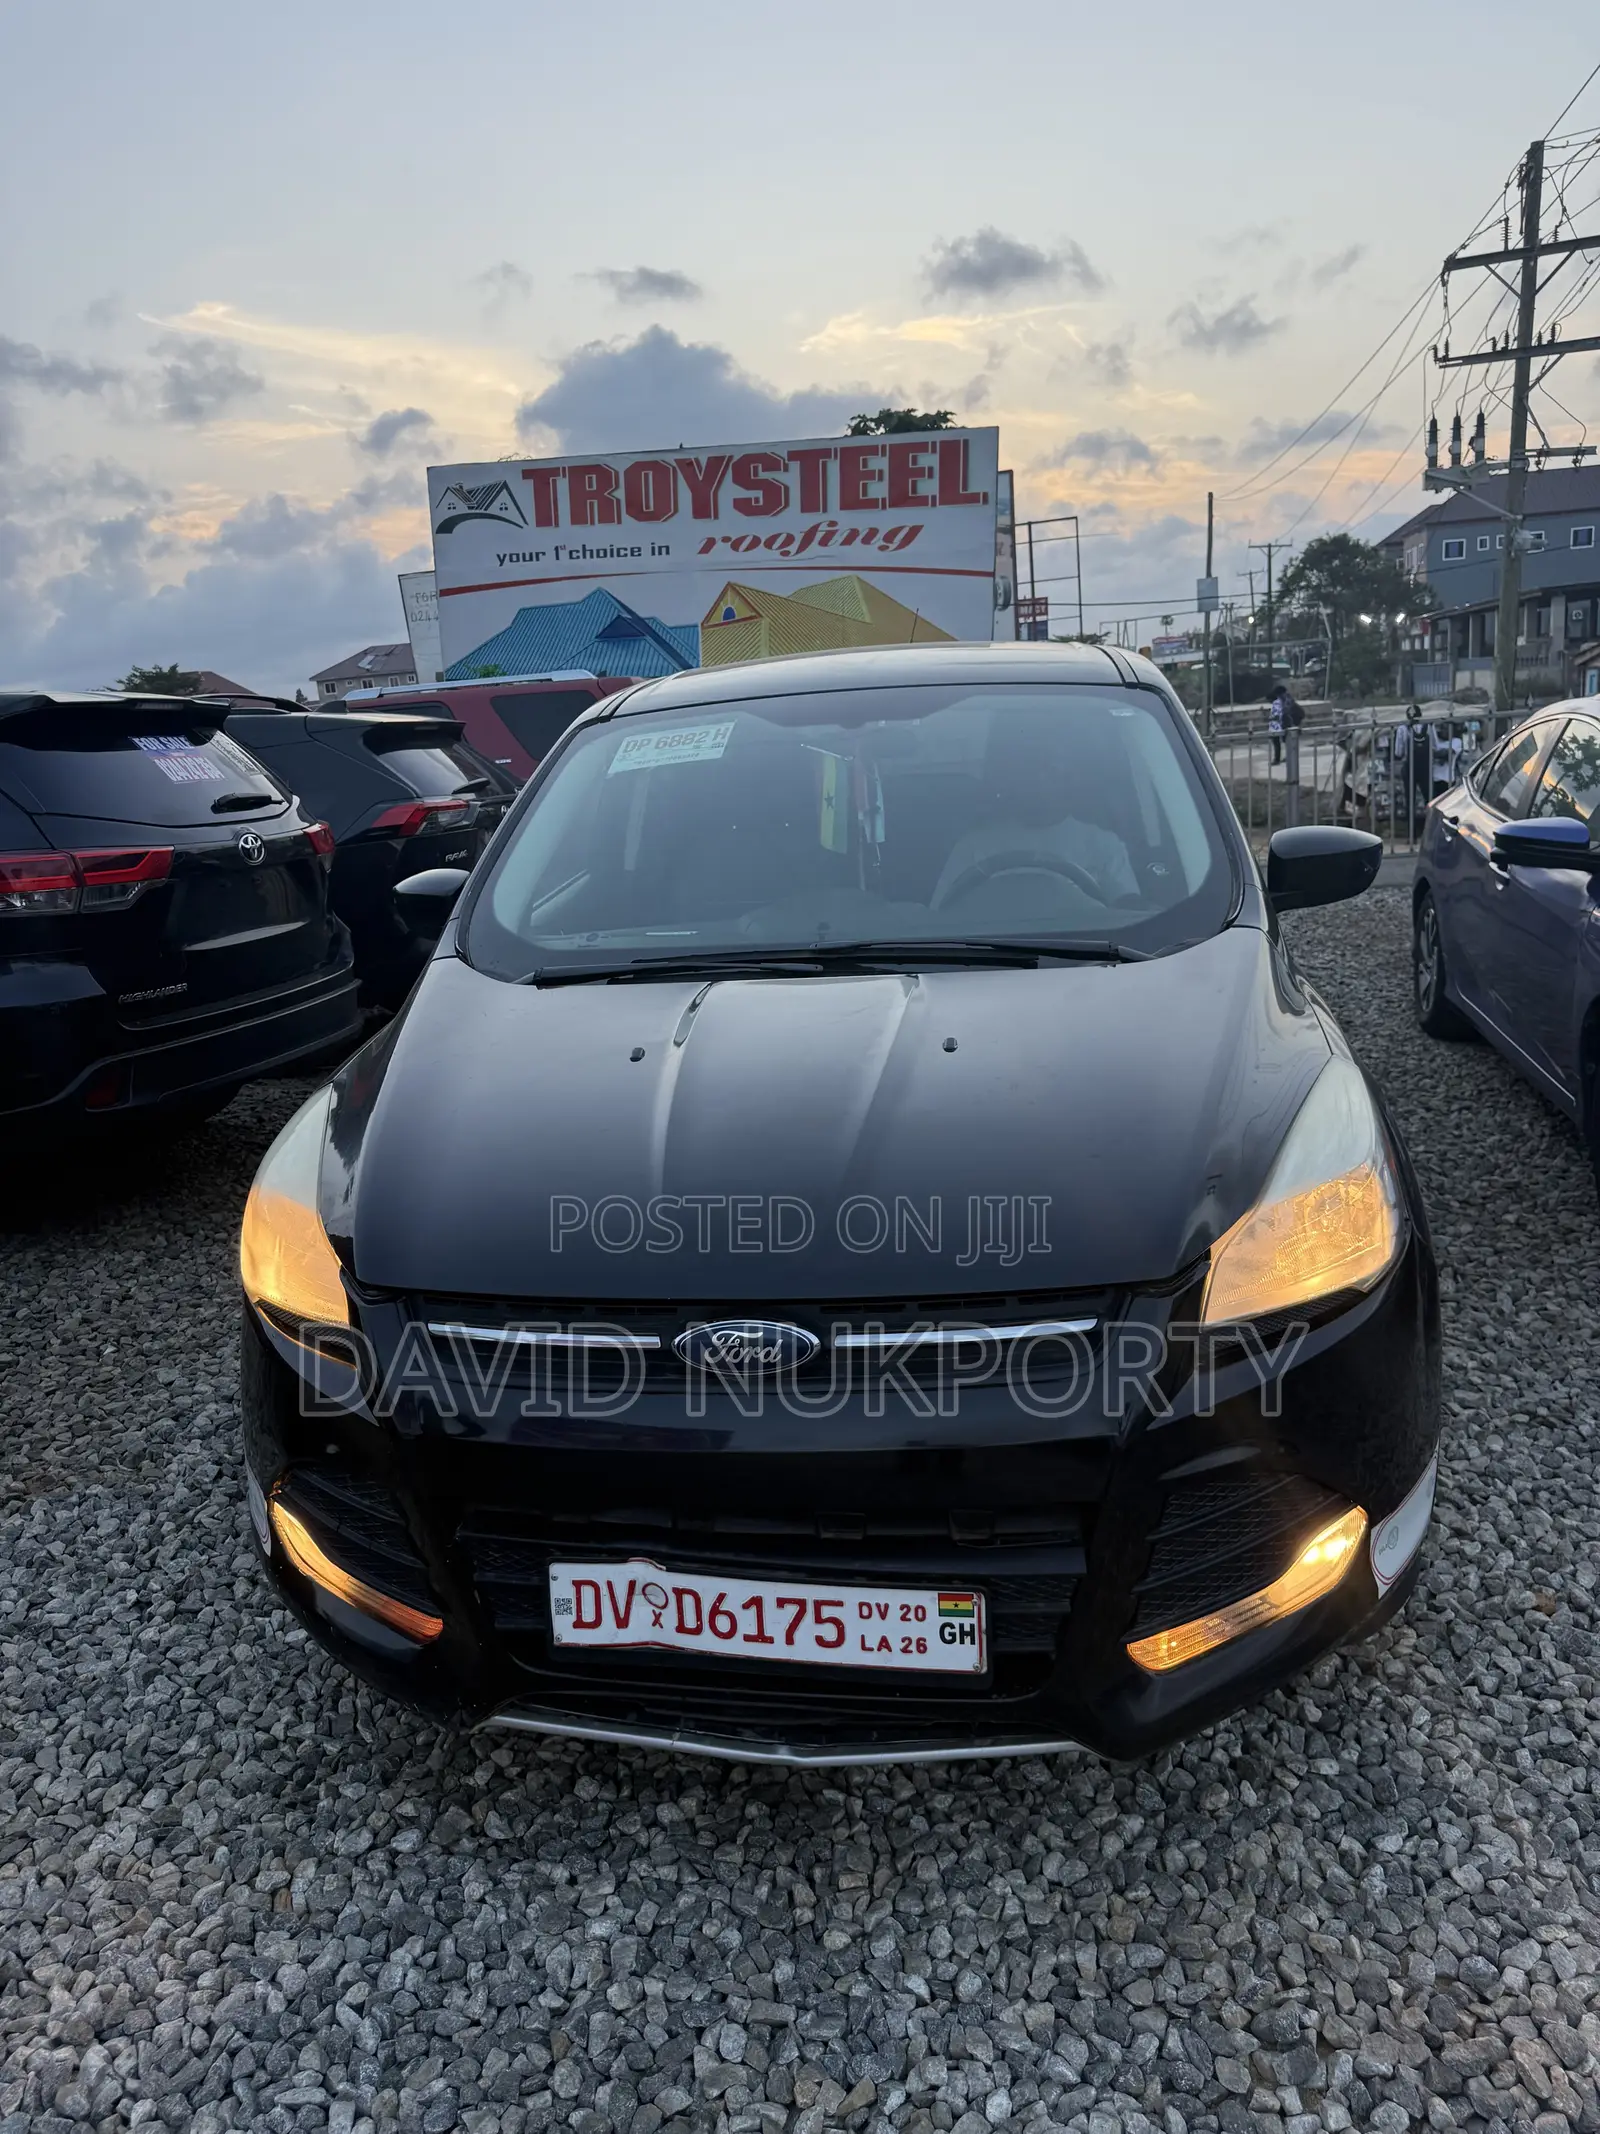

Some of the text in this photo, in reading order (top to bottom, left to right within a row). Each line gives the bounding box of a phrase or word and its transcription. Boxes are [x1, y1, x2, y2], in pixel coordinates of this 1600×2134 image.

[522, 438, 989, 529] TROYSTEEL
[496, 550, 546, 567] your
[568, 544, 642, 560] choice
[650, 542, 670, 557] in
[696, 519, 924, 557] roofing
[132, 736, 195, 751] FOR SALE
[623, 739, 653, 753] DP
[712, 728, 729, 741] H
[703, 1329, 784, 1365] Ford
[571, 1579, 637, 1629] DV
[671, 1586, 846, 1650] D6175
[857, 1602, 927, 1622] DV 20
[860, 1634, 928, 1654] LA 26
[938, 1621, 977, 1646] GH
